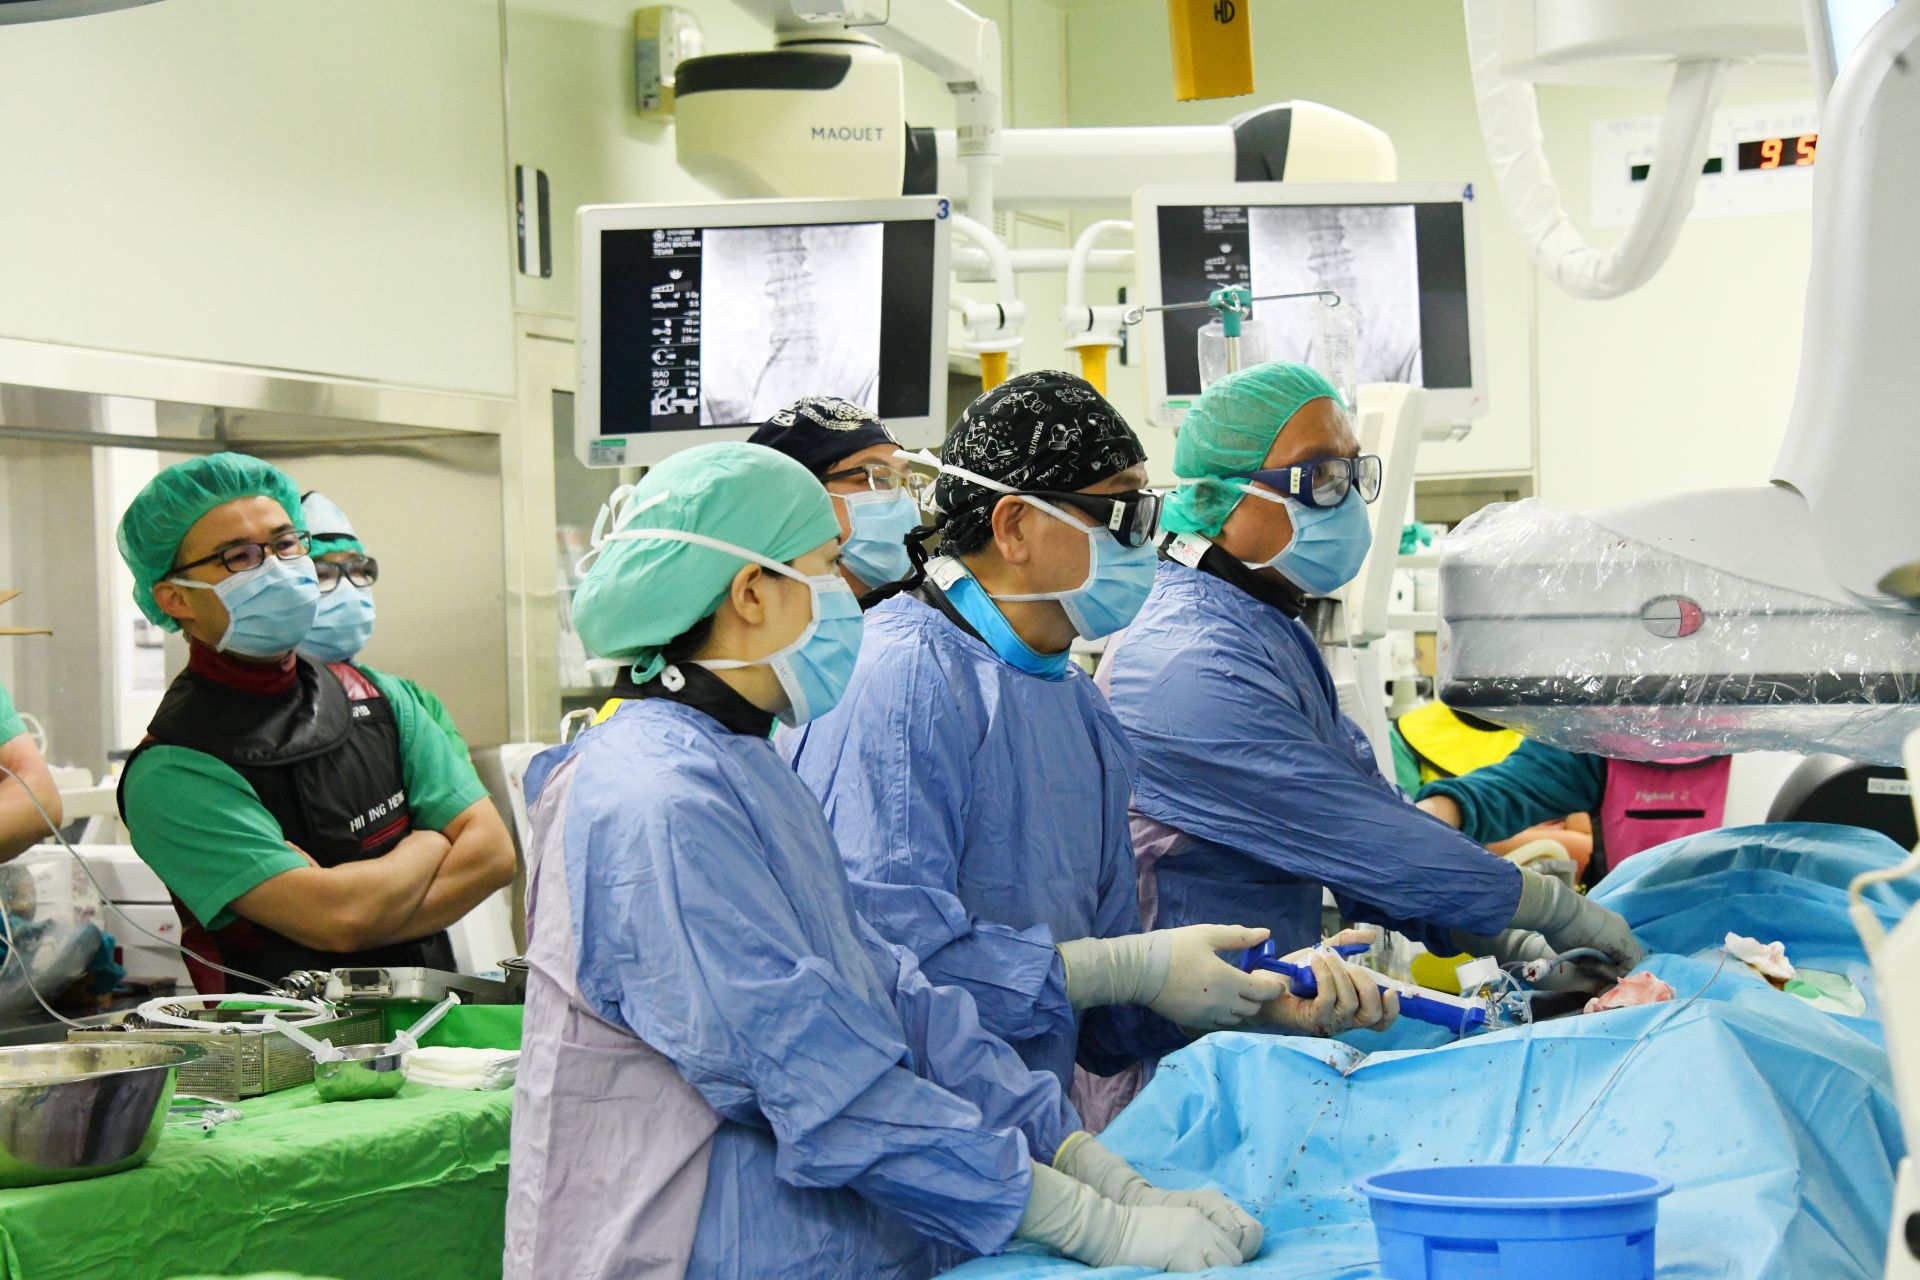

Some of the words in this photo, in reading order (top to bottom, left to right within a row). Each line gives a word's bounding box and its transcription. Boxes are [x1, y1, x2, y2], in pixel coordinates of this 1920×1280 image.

[1214, 0, 1236, 24] HD
[811, 127, 884, 141] MAQUET
[1463, 182, 1474, 202] 4
[936, 198, 950, 220] 3
[1028, 420, 1044, 455] PEANUTS
[368, 803, 387, 823] ING
